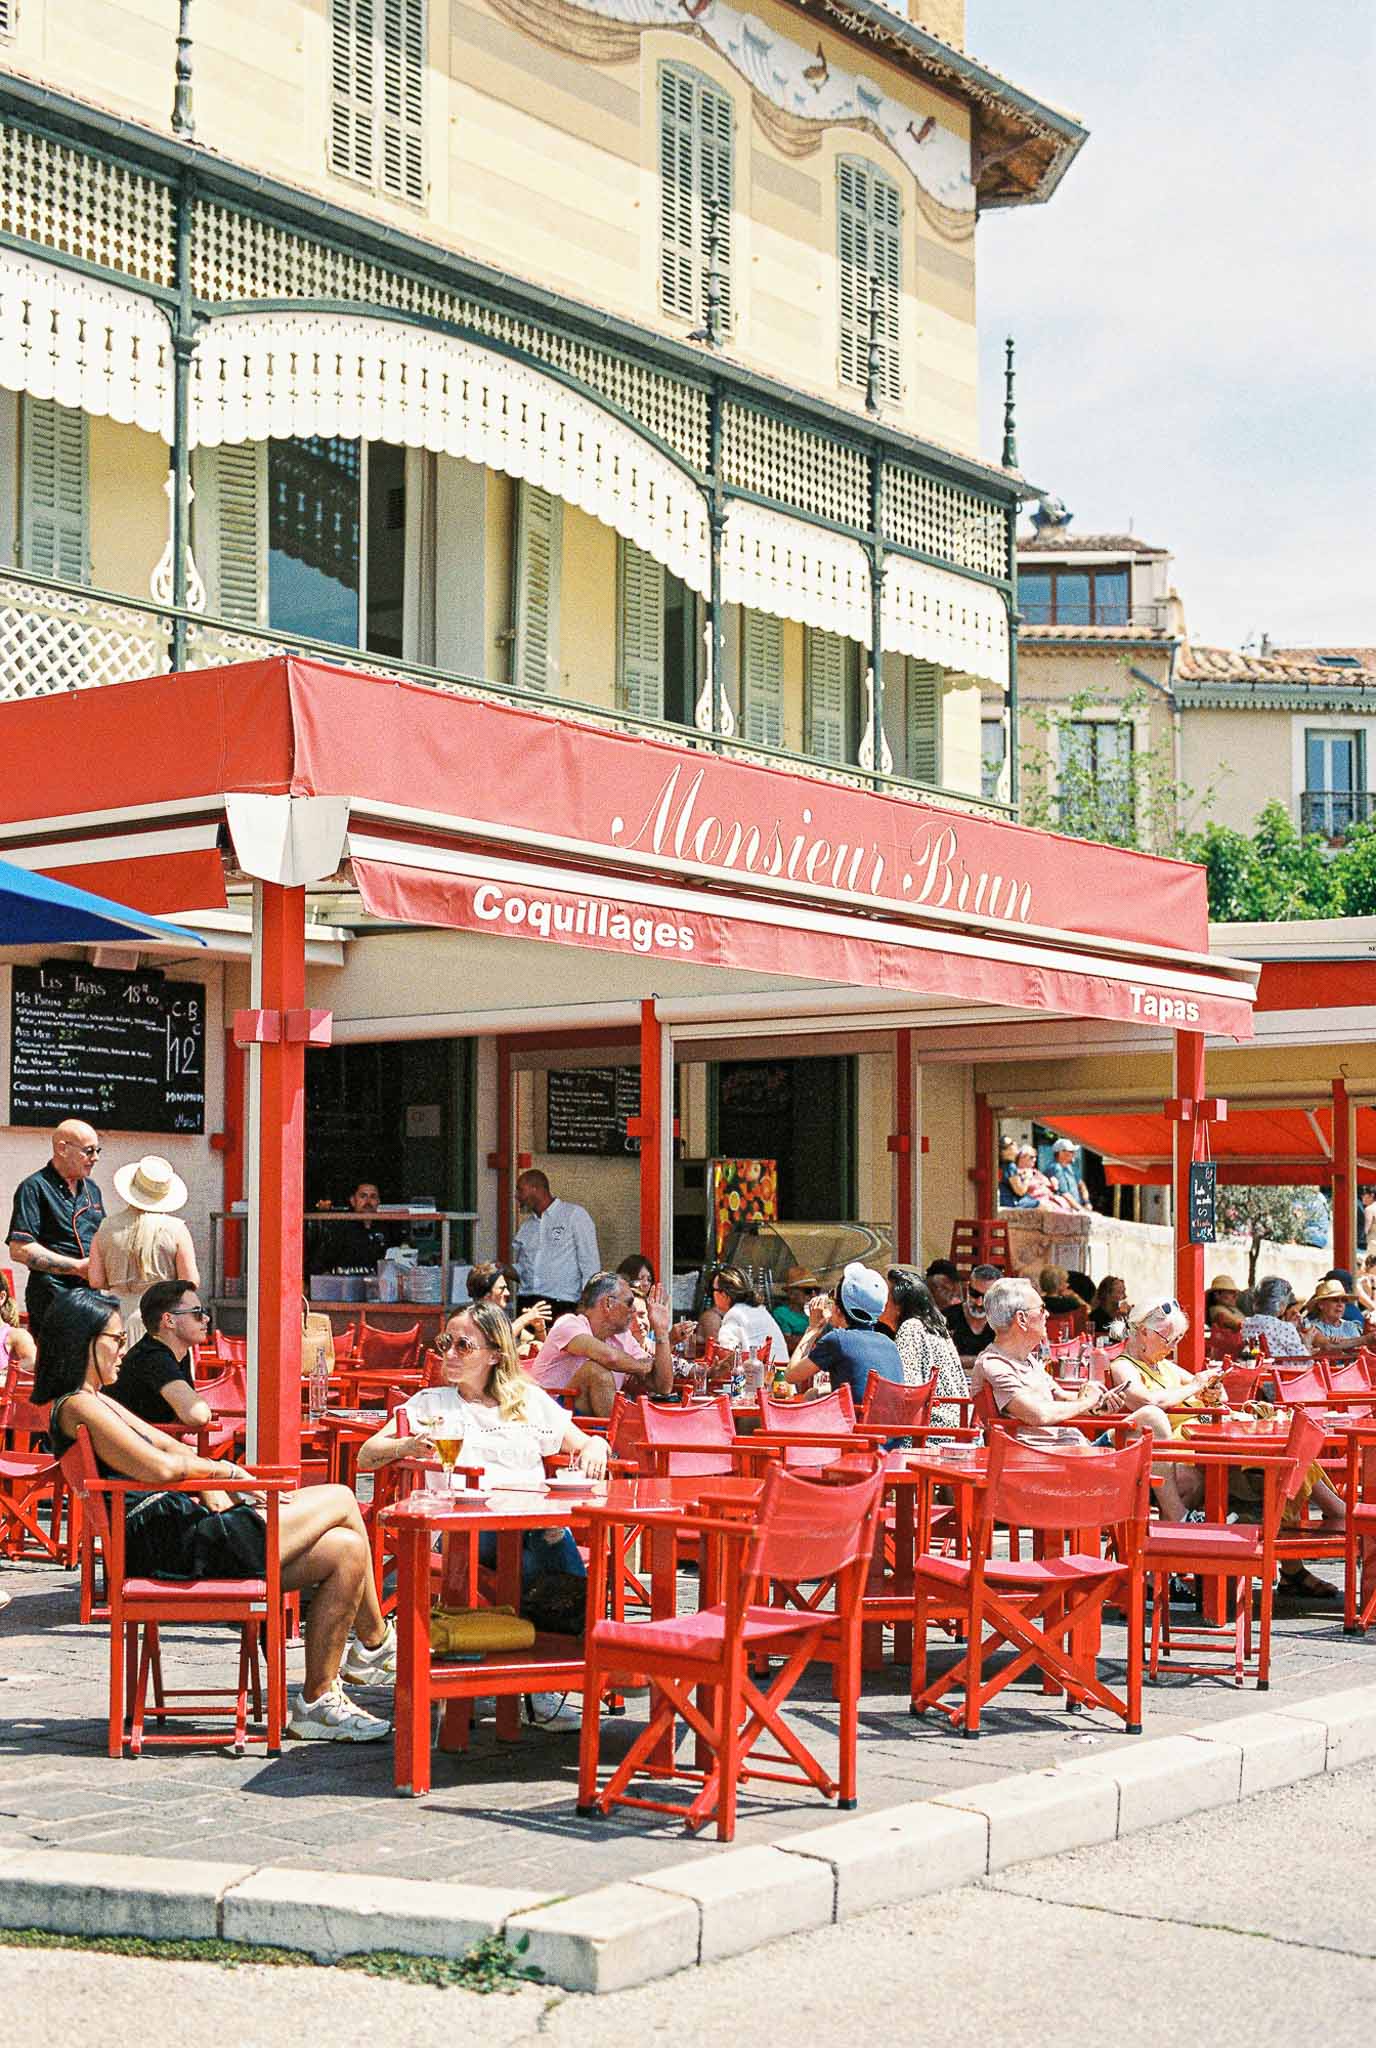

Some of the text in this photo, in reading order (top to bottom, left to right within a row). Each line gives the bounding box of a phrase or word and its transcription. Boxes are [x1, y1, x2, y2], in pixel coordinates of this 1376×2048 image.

[610, 763, 1034, 924] Monsieur Brun
[472, 884, 695, 952] Coquillages
[1129, 985, 1200, 1024] Tapas
